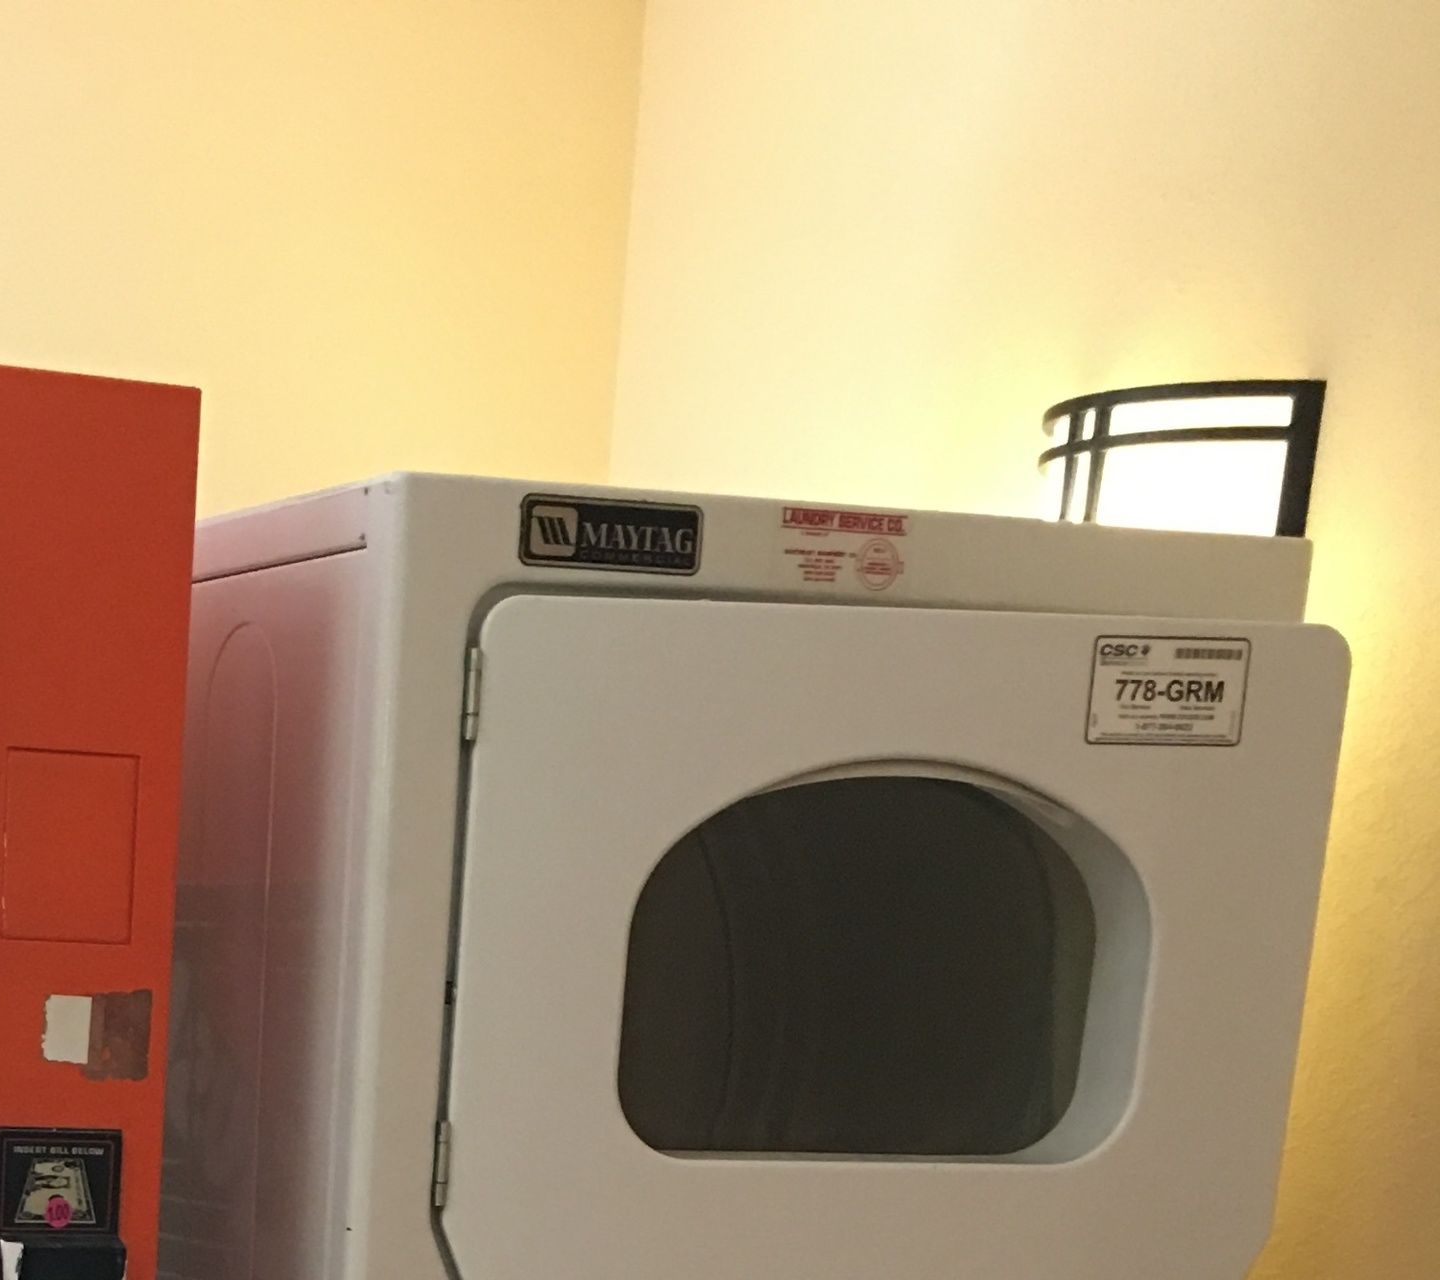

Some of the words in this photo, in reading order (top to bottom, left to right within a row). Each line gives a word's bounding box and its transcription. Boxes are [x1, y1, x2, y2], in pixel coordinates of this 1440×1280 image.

[838, 514, 885, 531] SERVICE
[580, 521, 694, 554] MAYTAG
[1099, 643, 1139, 657] CSC
[1115, 679, 1225, 703] 778-GRM
